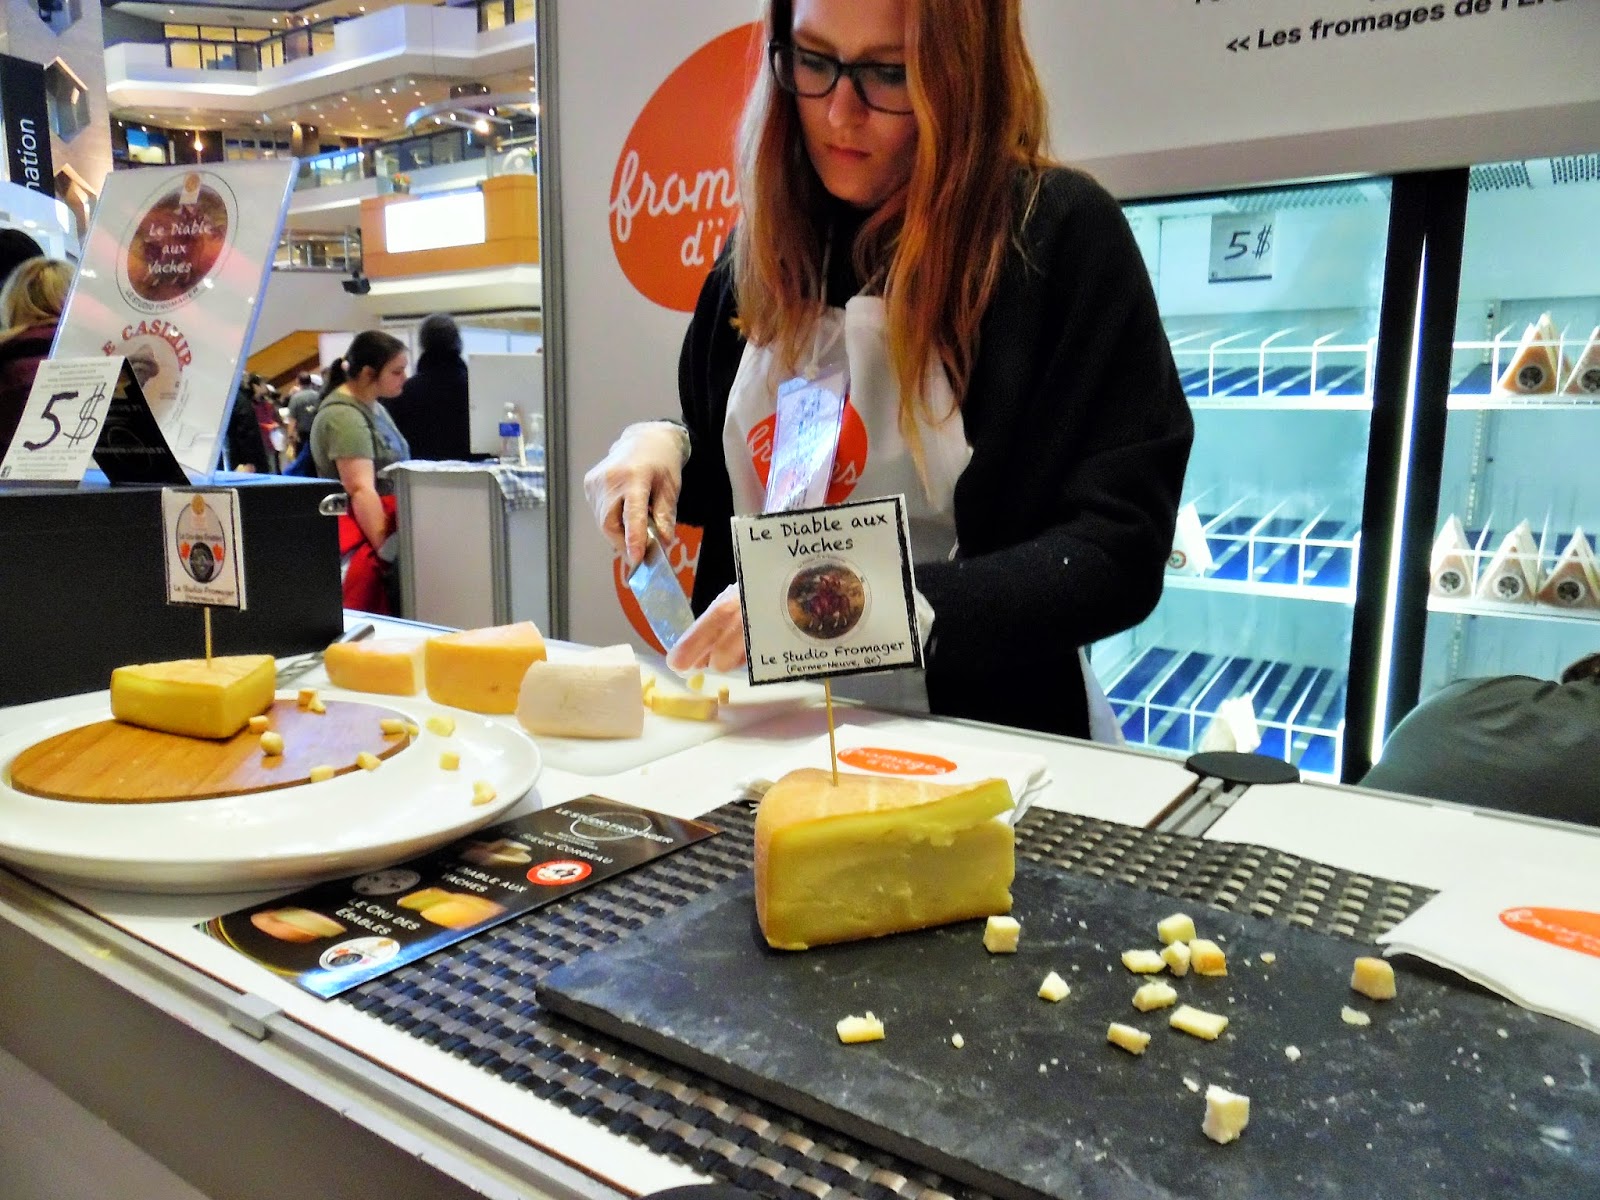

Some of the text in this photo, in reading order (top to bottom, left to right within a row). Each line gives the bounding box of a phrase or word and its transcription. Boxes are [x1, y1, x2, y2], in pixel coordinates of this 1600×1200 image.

[1257, 28, 1301, 49] Les
[1309, 4, 1445, 40] fromages
[1454, 0, 1492, 17] de
[609, 149, 741, 243] from
[149, 219, 213, 237] Le Diable
[161, 245, 187, 255] aux
[1224, 224, 1272, 261] 5$
[147, 260, 193, 274] Vaches
[23, 382, 107, 451] 5$
[750, 513, 888, 541] Le Diable aux
[787, 538, 854, 557] Vaches
[761, 641, 905, 665] Le Studio Fromager
[500, 881, 528, 893] AUX
[366, 904, 395, 920] CRU
[392, 916, 421, 931] DES
